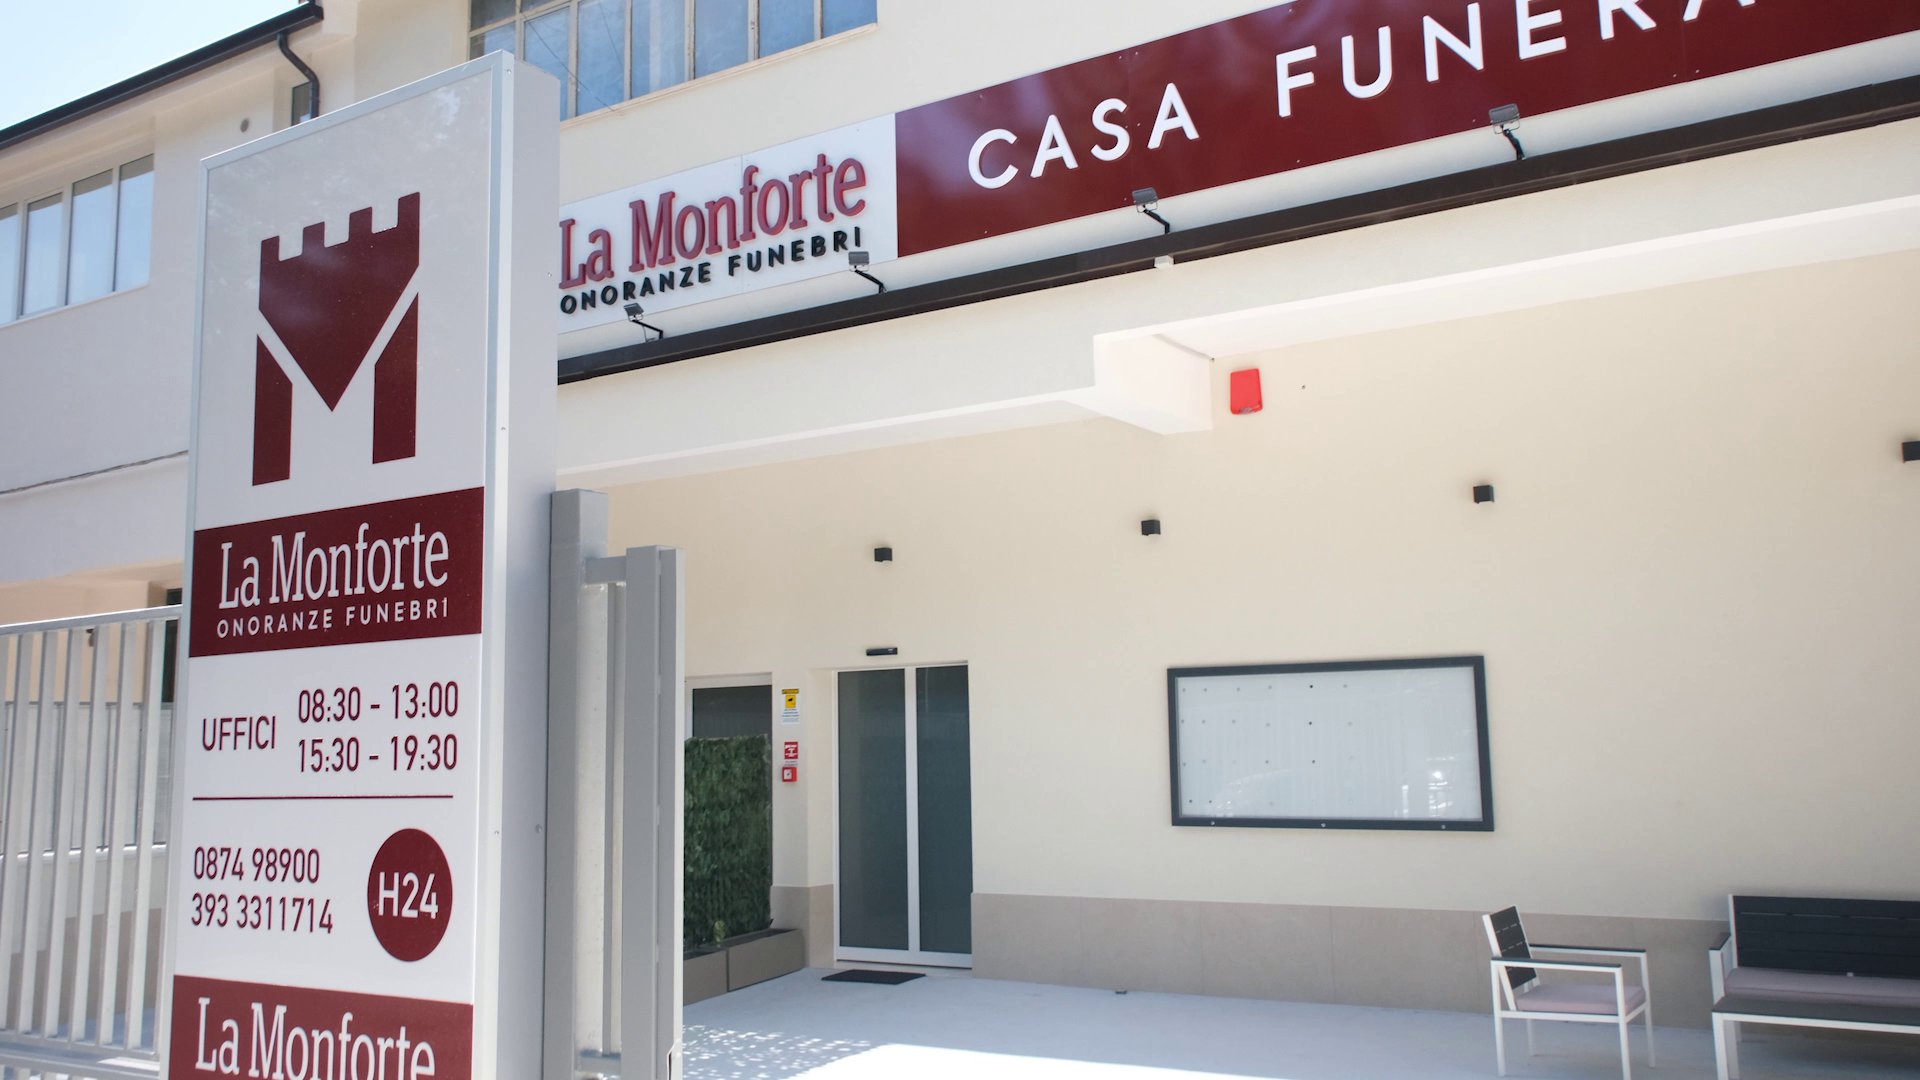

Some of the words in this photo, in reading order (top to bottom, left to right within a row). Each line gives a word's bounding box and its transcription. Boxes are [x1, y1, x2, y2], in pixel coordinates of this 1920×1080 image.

[968, 82, 1200, 189] CASA
[559, 218, 614, 289] La
[628, 153, 866, 272] Monforte
[560, 262, 711, 314] ONORANZE
[728, 226, 861, 277] FUNEBRI
[219, 541, 260, 609] La
[269, 522, 449, 604] Monforte
[217, 608, 332, 639] ONORANZE
[346, 597, 448, 626] FUNEBRI
[298, 686, 361, 723] 08:30
[392, 681, 459, 719] 13:00
[202, 716, 276, 751] UFFICI
[298, 736, 359, 773] 15:30
[391, 734, 457, 771] 19:30
[193, 847, 244, 881] 0874
[252, 848, 320, 883] 98900
[191, 893, 228, 927] 393
[237, 895, 333, 934] 3311714
[378, 872, 438, 919] H24
[195, 997, 239, 1075] La
[248, 1002, 435, 1080] Monforte
